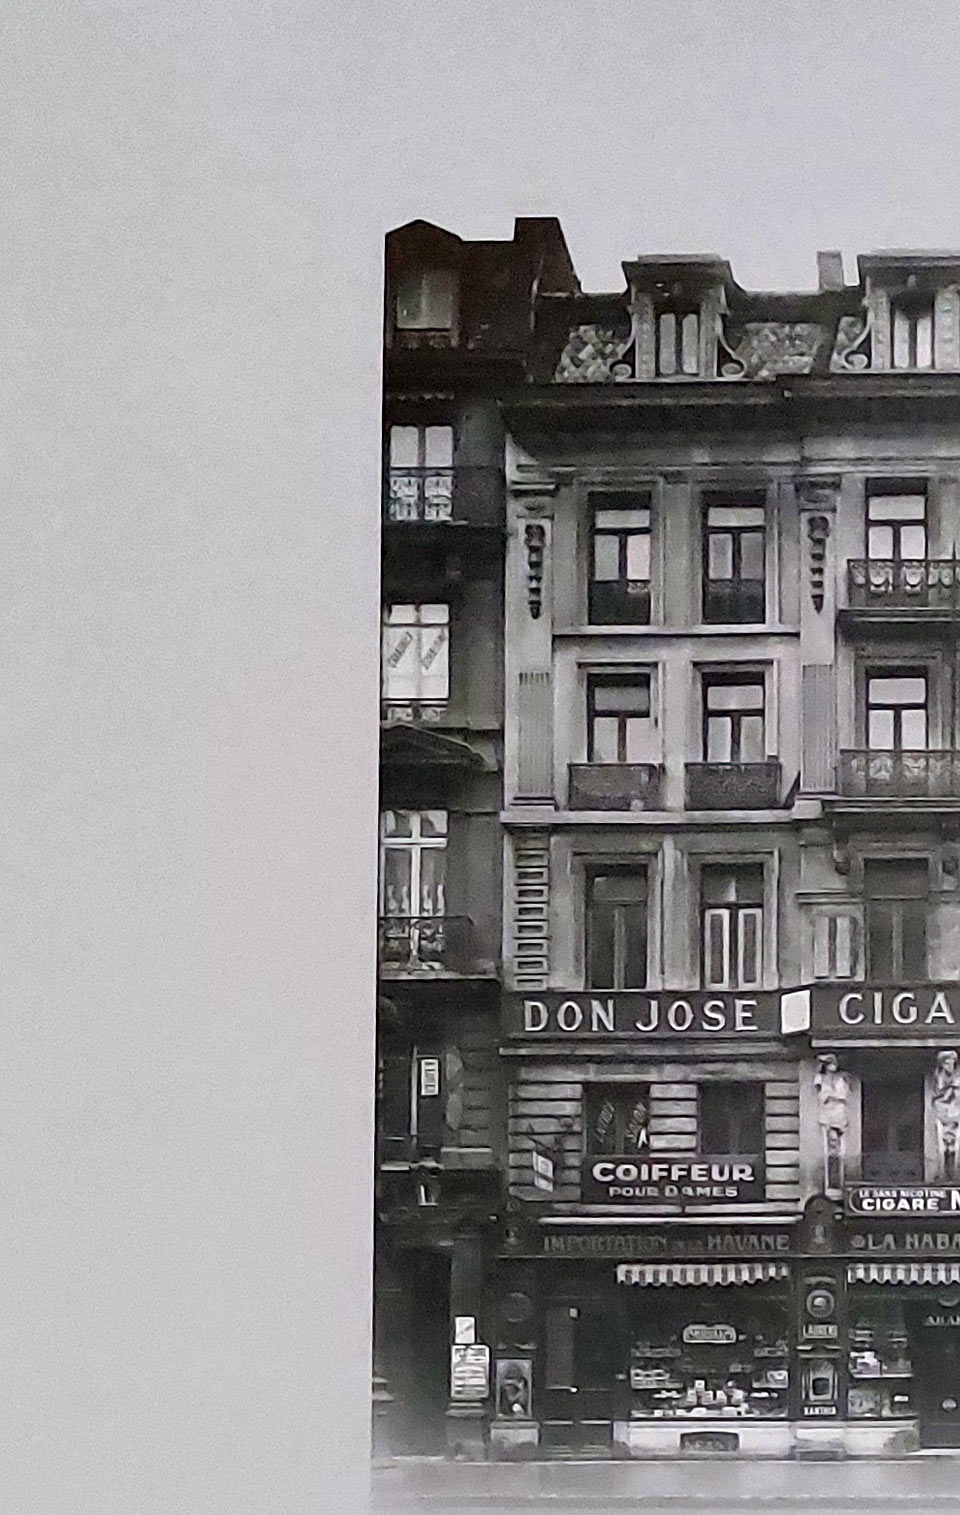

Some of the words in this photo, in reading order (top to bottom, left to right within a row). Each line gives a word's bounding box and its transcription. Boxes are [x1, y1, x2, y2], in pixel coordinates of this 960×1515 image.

[523, 998, 615, 1032] DON
[635, 999, 759, 1032] JOSE
[592, 1162, 755, 1182] COIFFEUR
[608, 1185, 660, 1198] POUR
[664, 1184, 739, 1198] DAMES
[861, 1198, 941, 1211] CIGARE
[707, 1233, 790, 1251] HAVANE
[867, 1233, 897, 1250] LA
